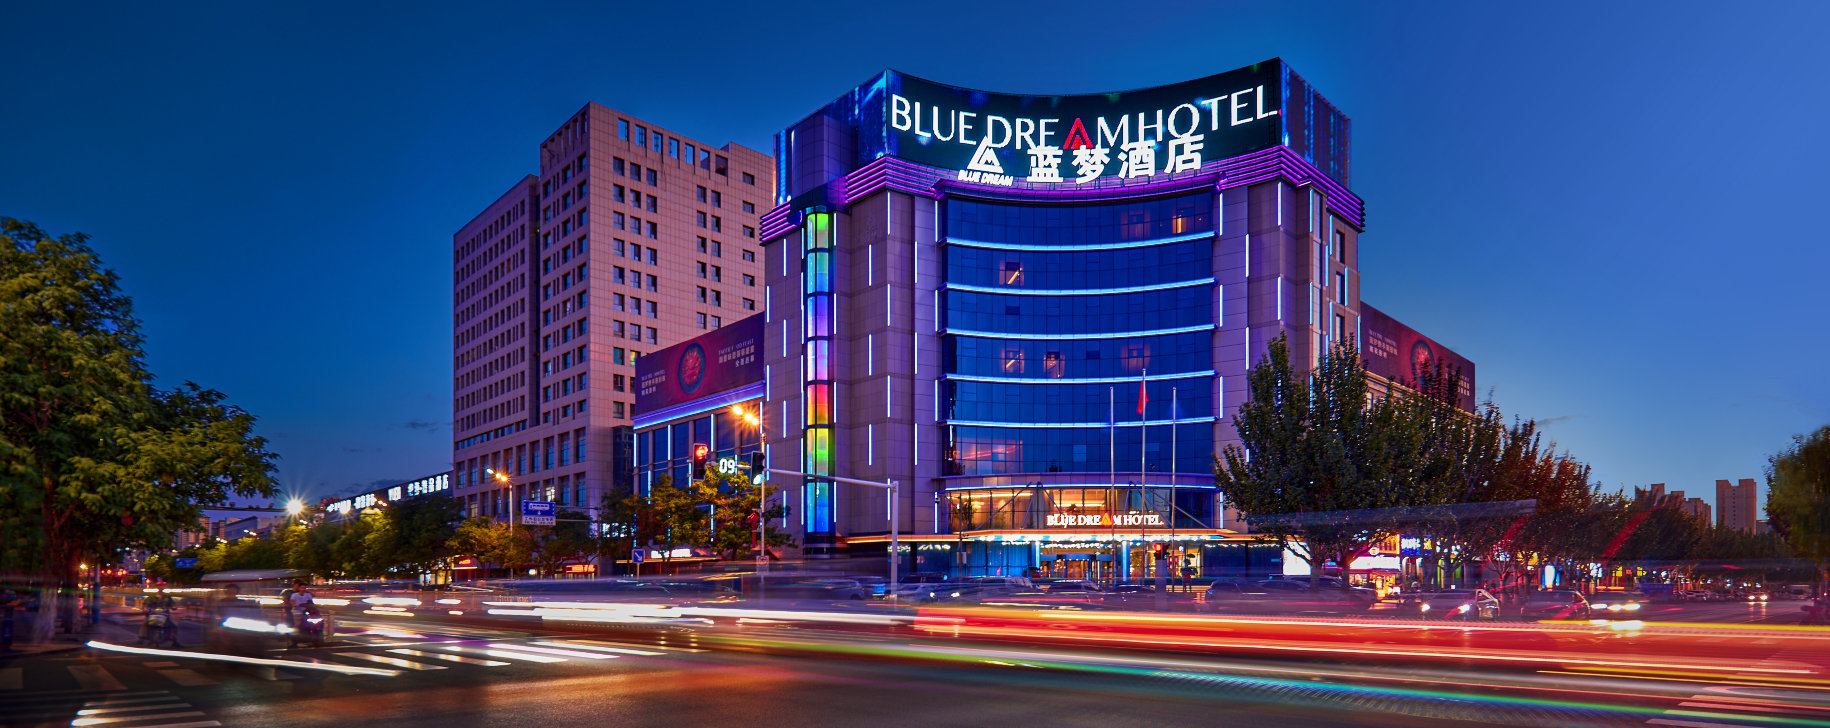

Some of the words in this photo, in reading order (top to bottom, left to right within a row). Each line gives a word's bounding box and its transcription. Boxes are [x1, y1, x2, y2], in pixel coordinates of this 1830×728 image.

[891, 93, 977, 145] BLUE
[986, 114, 1130, 150] DREAM
[1138, 84, 1278, 143] HOTEL
[1026, 133, 1205, 185] 蓝梦酒店
[958, 169, 981, 183] BLUE
[981, 172, 1014, 187] DREAM
[718, 458, 735, 473] 09
[1046, 513, 1077, 527] BLUE
[1077, 513, 1122, 526] DREAM
[1123, 514, 1164, 526] HOTEL
